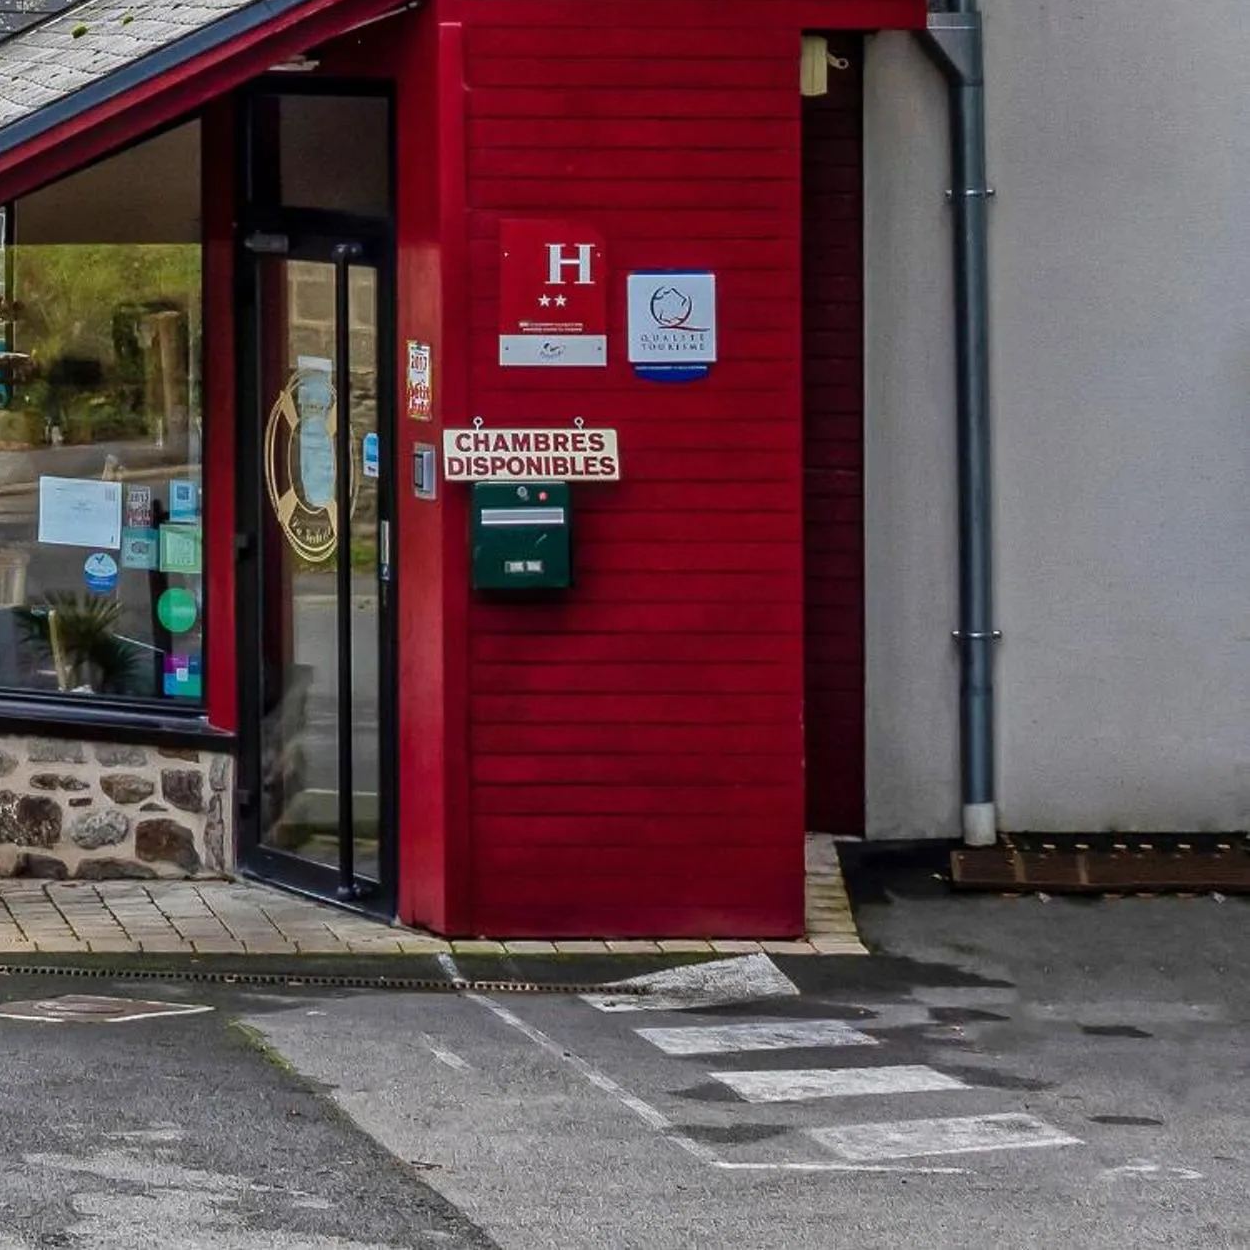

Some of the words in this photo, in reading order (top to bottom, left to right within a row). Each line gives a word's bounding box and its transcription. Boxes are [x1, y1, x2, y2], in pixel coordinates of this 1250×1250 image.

[545, 243, 596, 284] H
[454, 432, 605, 453] CHAMBRES
[447, 456, 616, 476] DISPONIBLES
